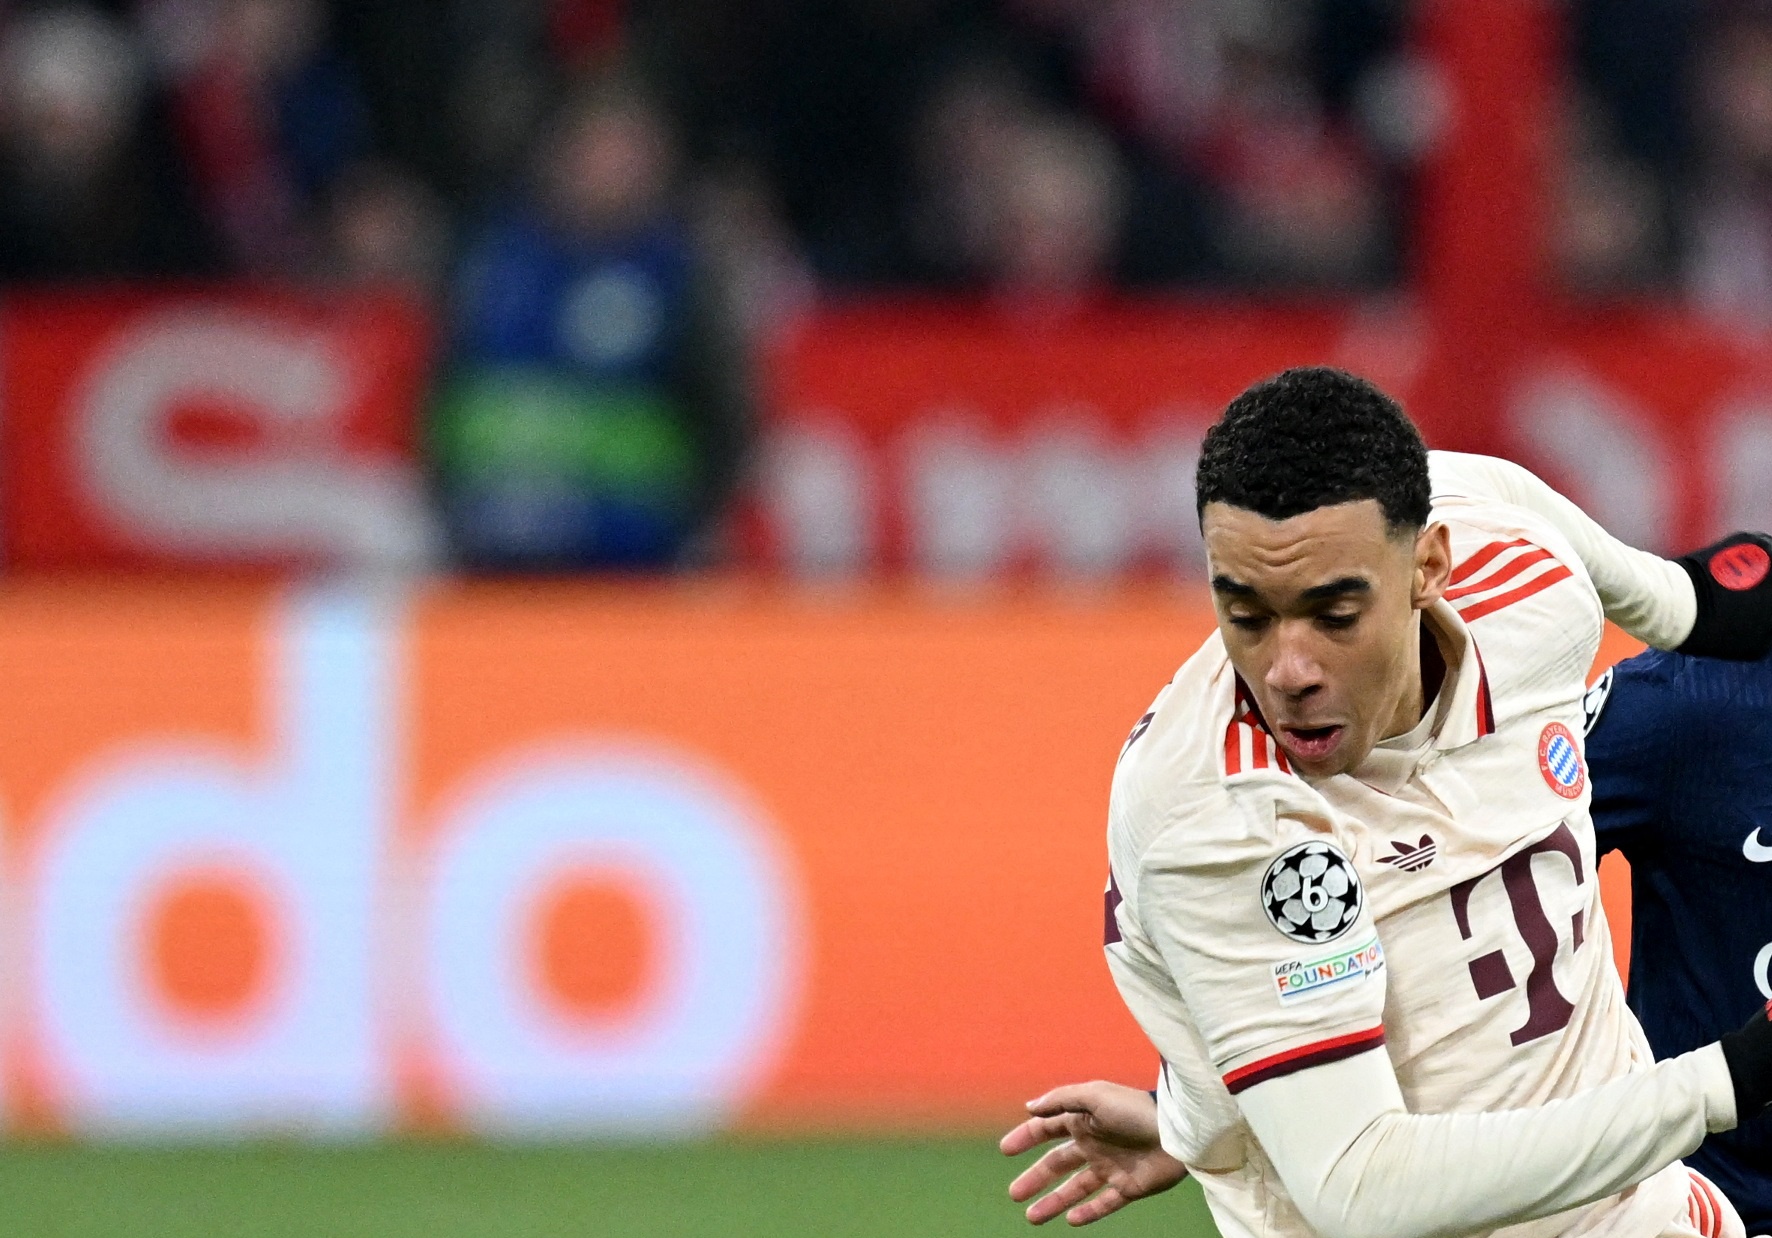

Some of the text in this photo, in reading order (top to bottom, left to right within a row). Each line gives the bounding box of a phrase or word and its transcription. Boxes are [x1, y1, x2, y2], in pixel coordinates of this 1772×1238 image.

[1302, 876, 1329, 912] 6
[1450, 820, 1585, 1047] T
[1275, 961, 1302, 976] UEFA
